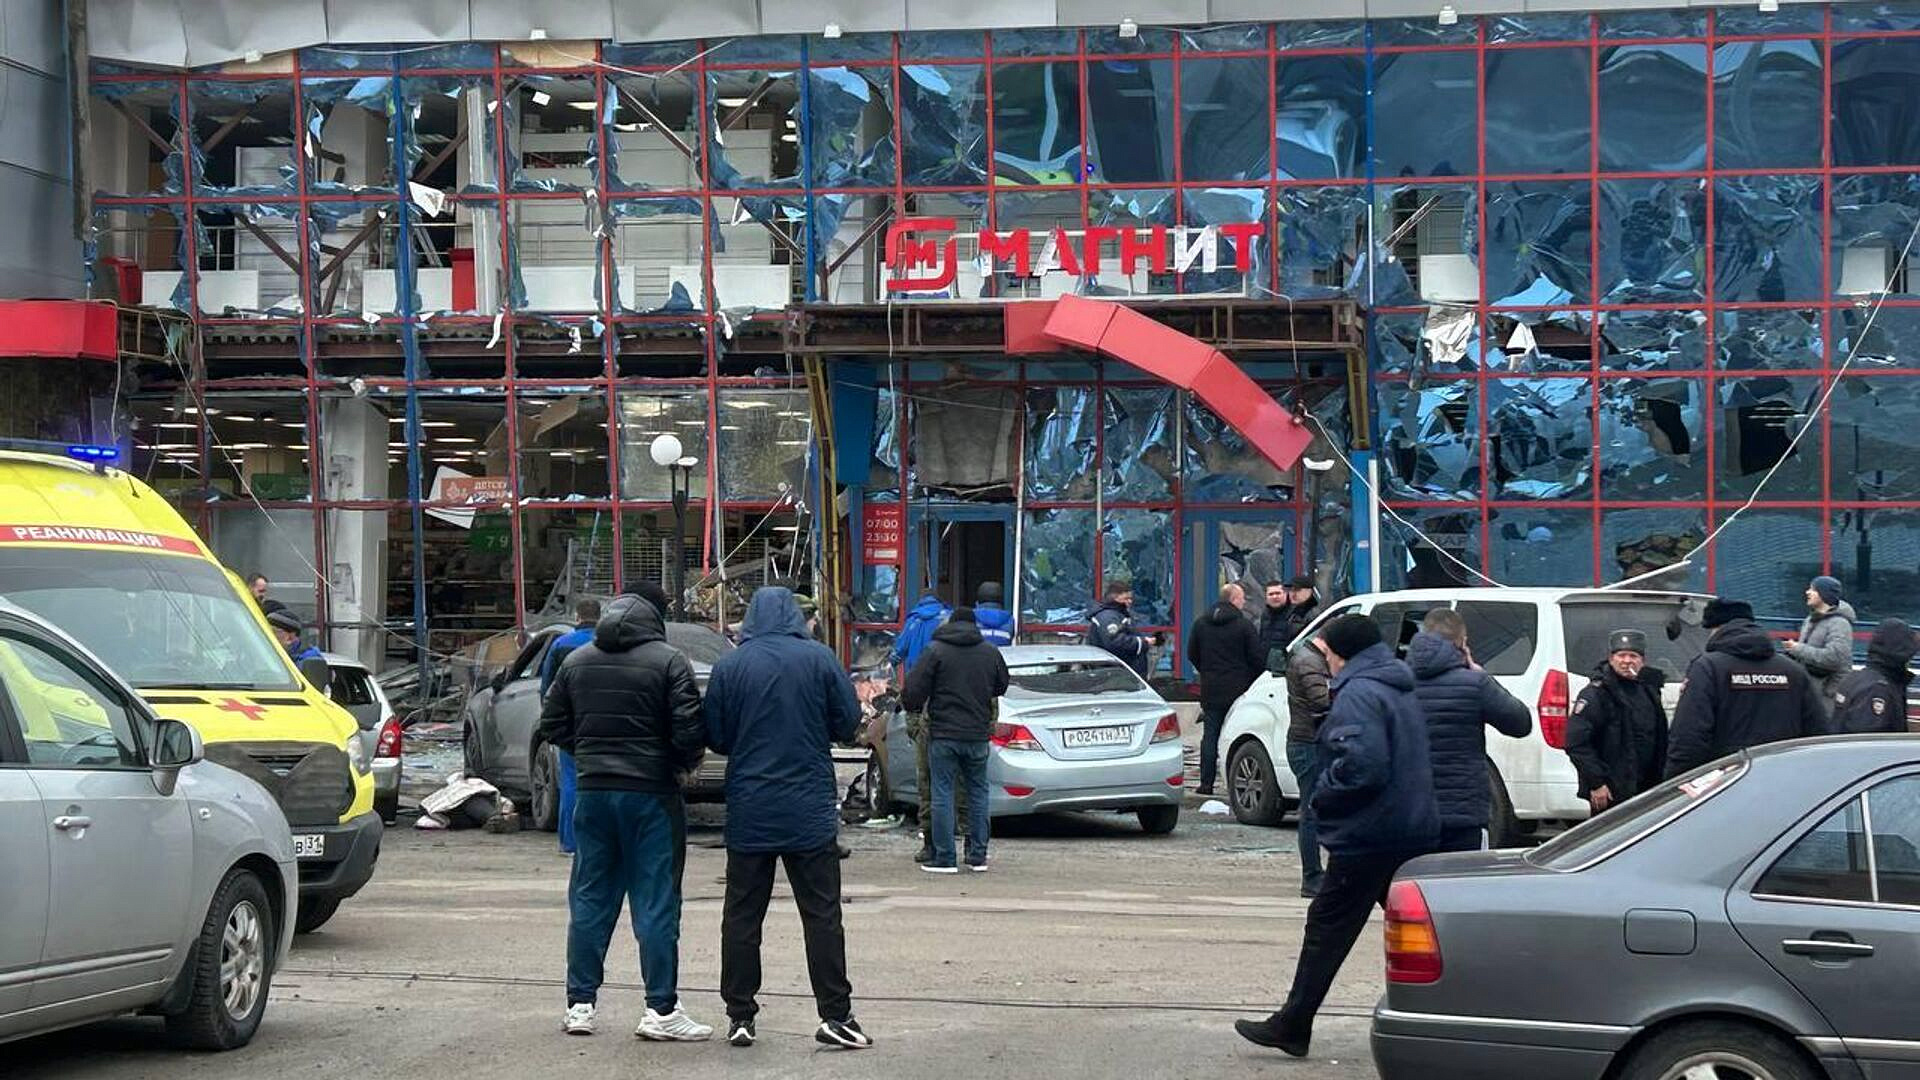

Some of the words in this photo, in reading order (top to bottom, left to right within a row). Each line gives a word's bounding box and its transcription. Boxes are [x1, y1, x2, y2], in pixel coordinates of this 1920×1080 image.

[979, 223, 1264, 277] МАГНИТ
[12, 526, 163, 547] РЕАНИМАЦИЯ
[1731, 674, 1751, 685] МВД
[1752, 674, 1788, 685] РОССИИ
